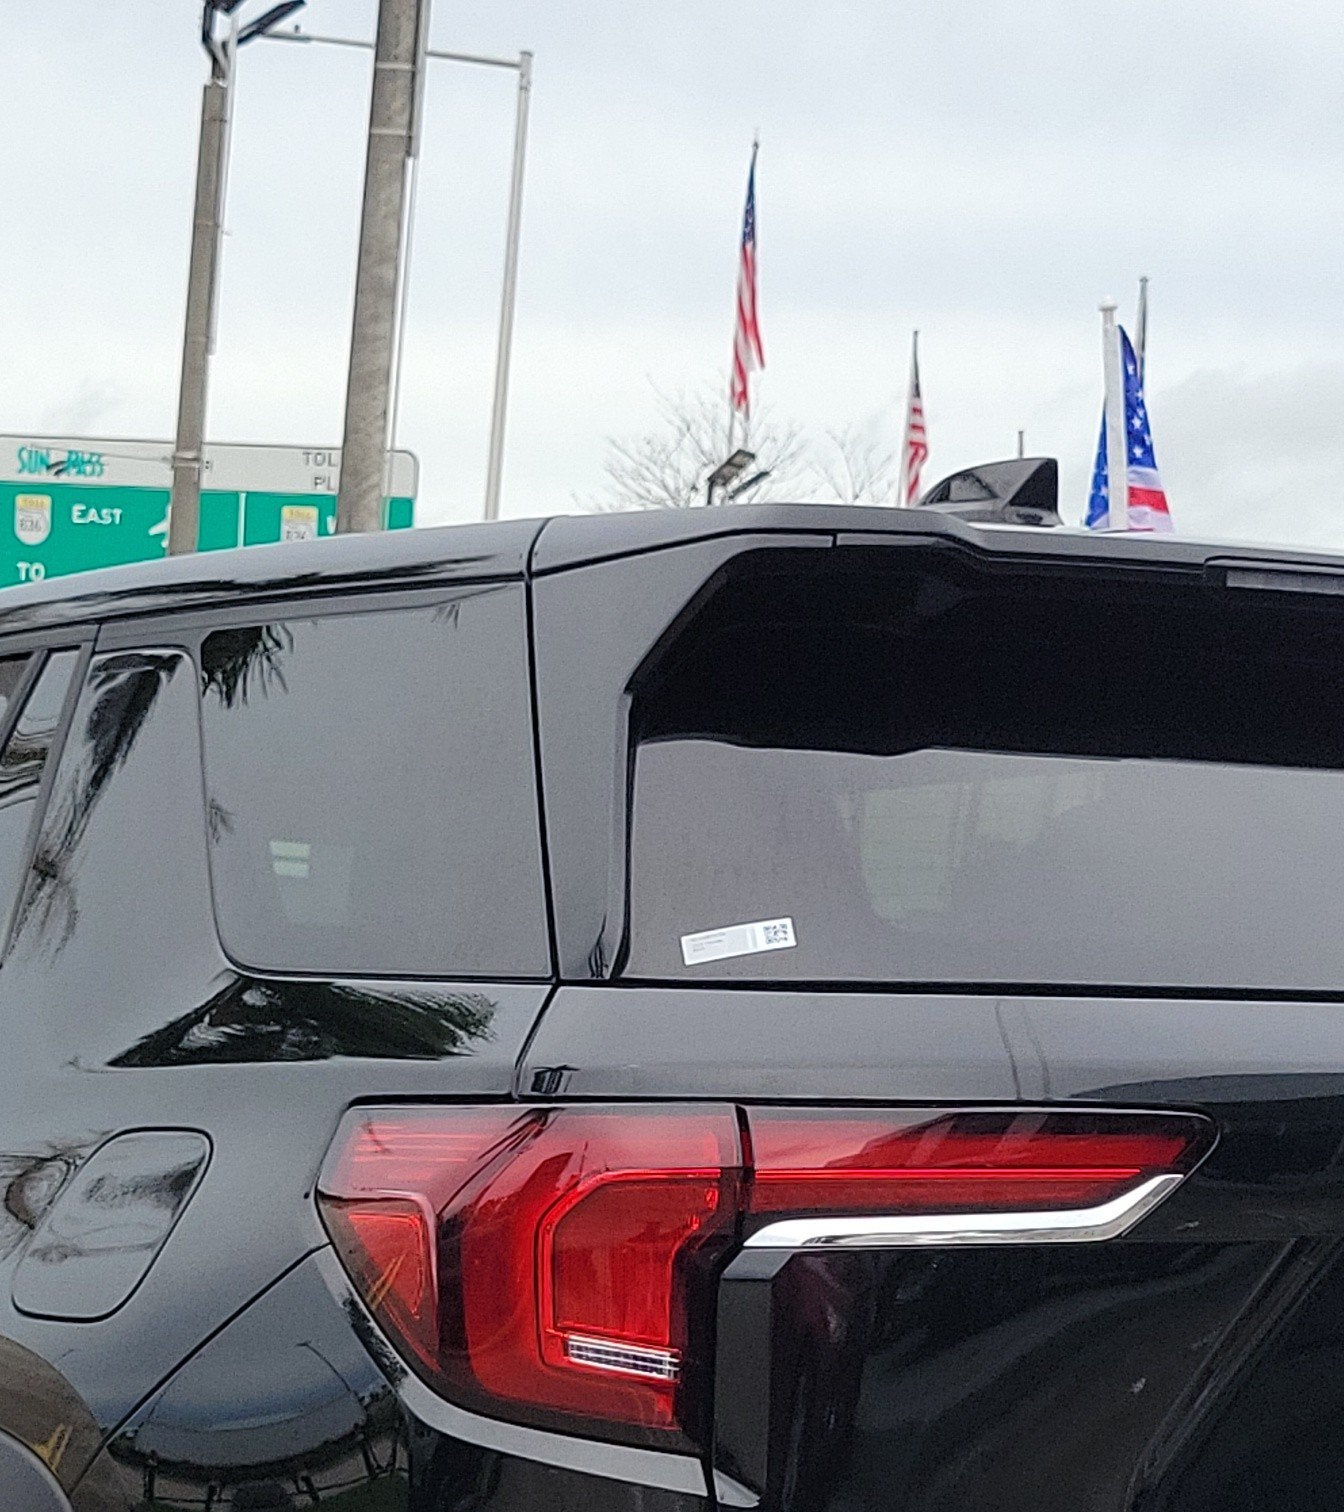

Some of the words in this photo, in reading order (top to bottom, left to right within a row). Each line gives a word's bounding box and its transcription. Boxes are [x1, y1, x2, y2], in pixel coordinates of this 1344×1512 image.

[302, 452, 339, 467] TOL
[71, 504, 123, 525] EAST
[17, 562, 45, 581] TO
